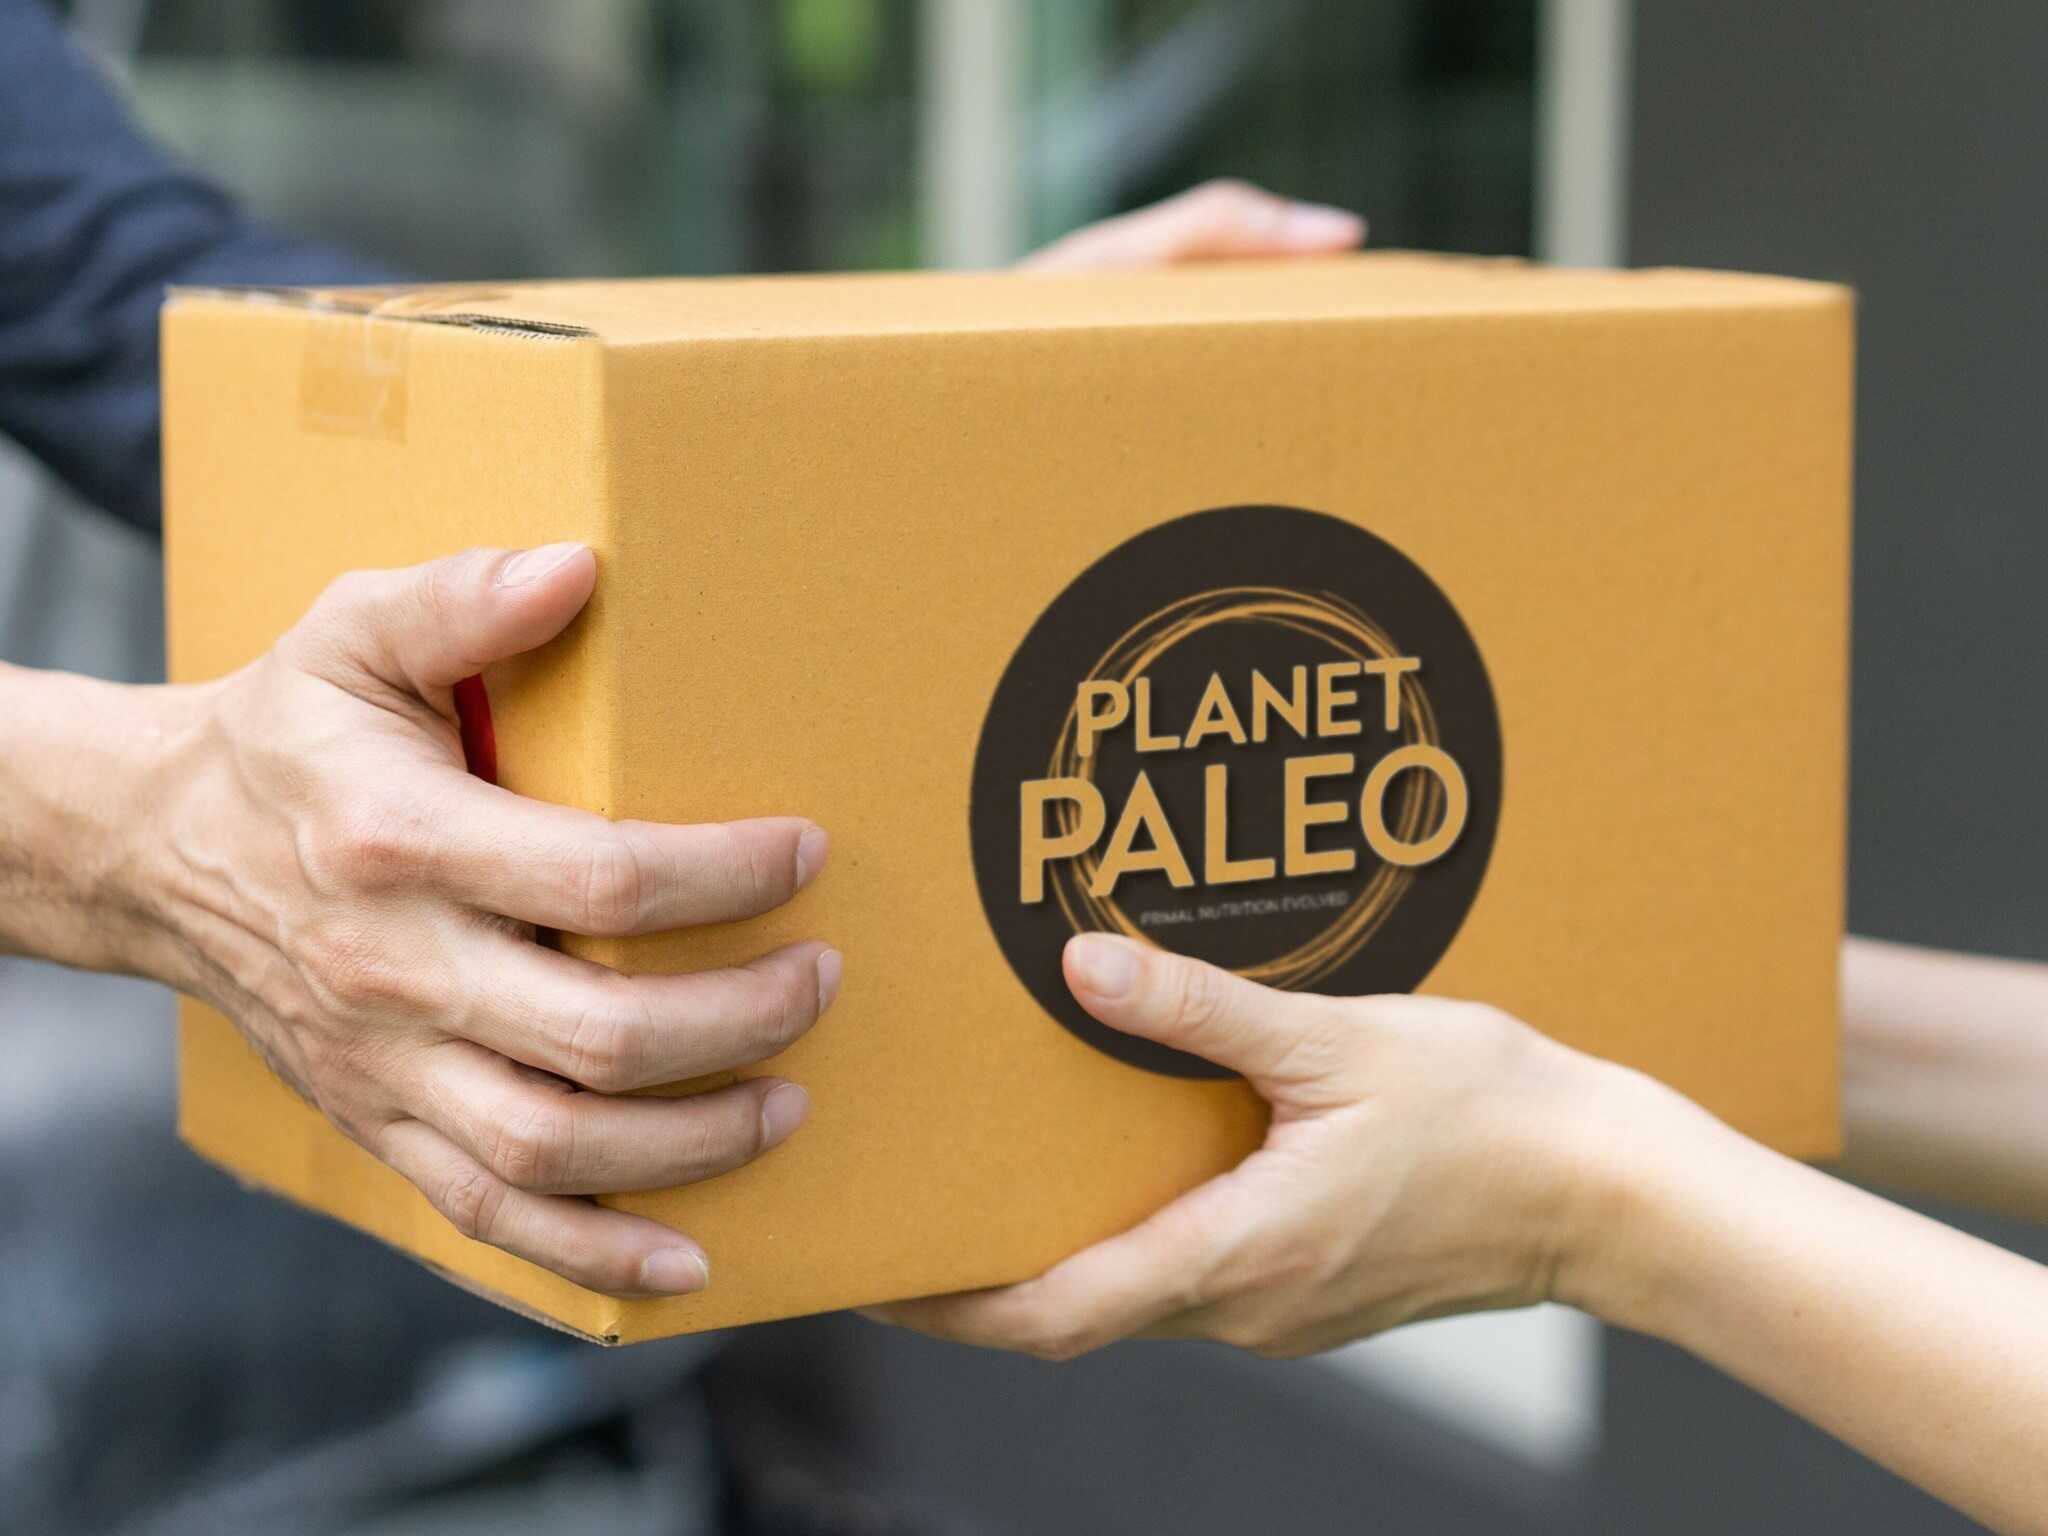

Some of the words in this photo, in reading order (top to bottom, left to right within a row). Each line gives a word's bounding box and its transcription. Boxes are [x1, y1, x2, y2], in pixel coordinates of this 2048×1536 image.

[1077, 657, 1420, 756] PLANET
[1020, 744, 1467, 903] PALEO
[1199, 899, 1279, 920] NUTRITION
[1282, 891, 1348, 912] EVOLVED
